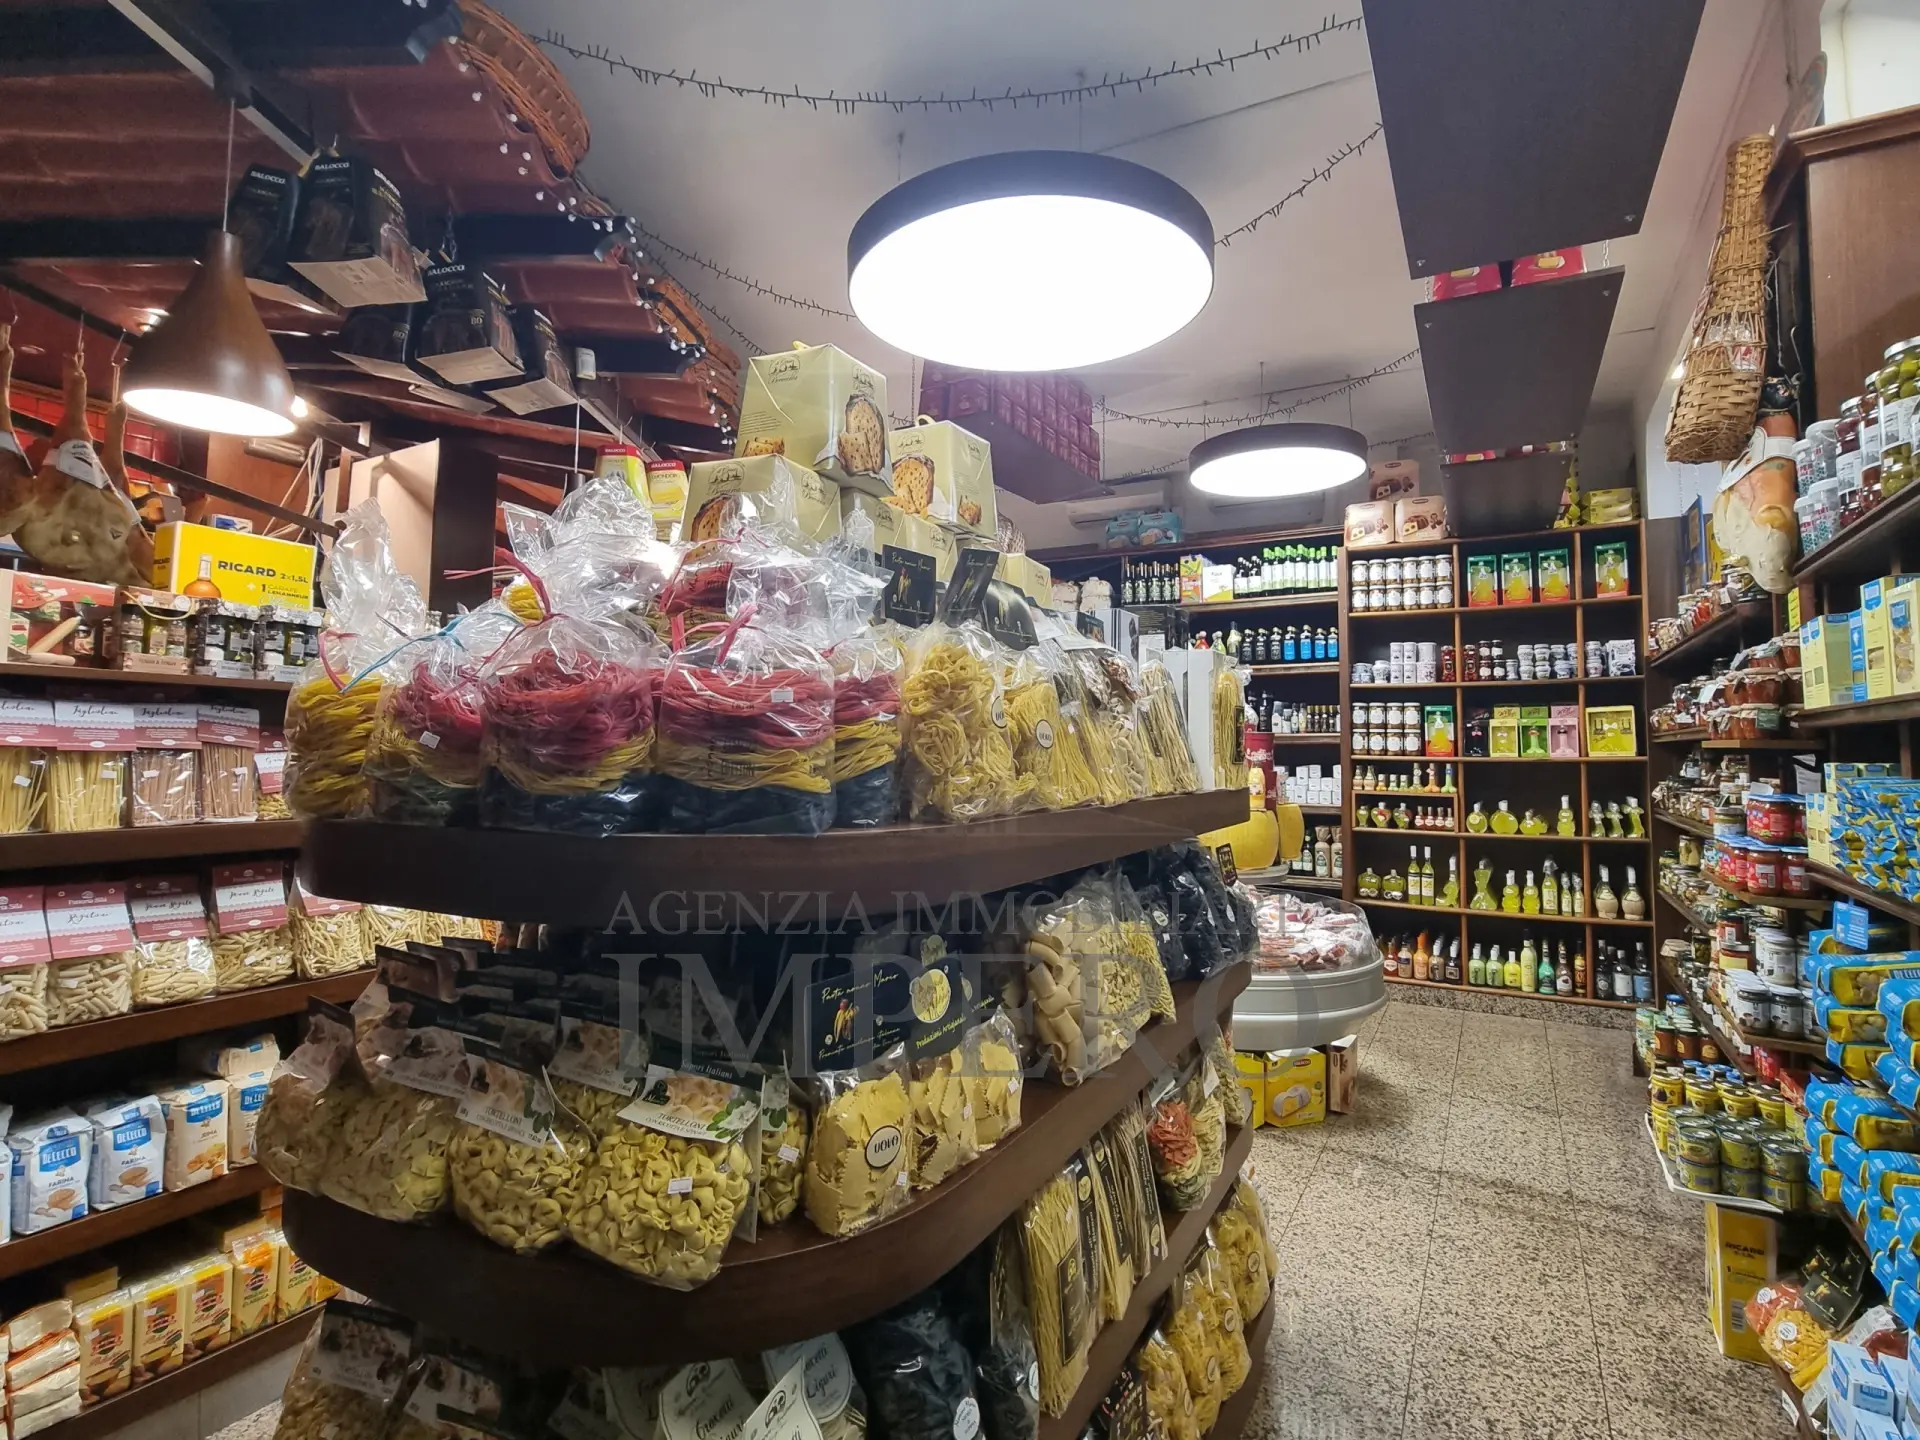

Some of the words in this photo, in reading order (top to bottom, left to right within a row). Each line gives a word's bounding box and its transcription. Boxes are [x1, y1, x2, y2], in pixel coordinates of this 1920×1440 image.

[217, 560, 277, 577] RICARD
[821, 986, 844, 1002] Pasta
[873, 968, 900, 988] Marco
[681, 1060, 704, 1072] Sapori
[705, 1065, 733, 1079] Italiani
[873, 1133, 900, 1154] UOVO
[805, 1364, 838, 1399] Liguri
